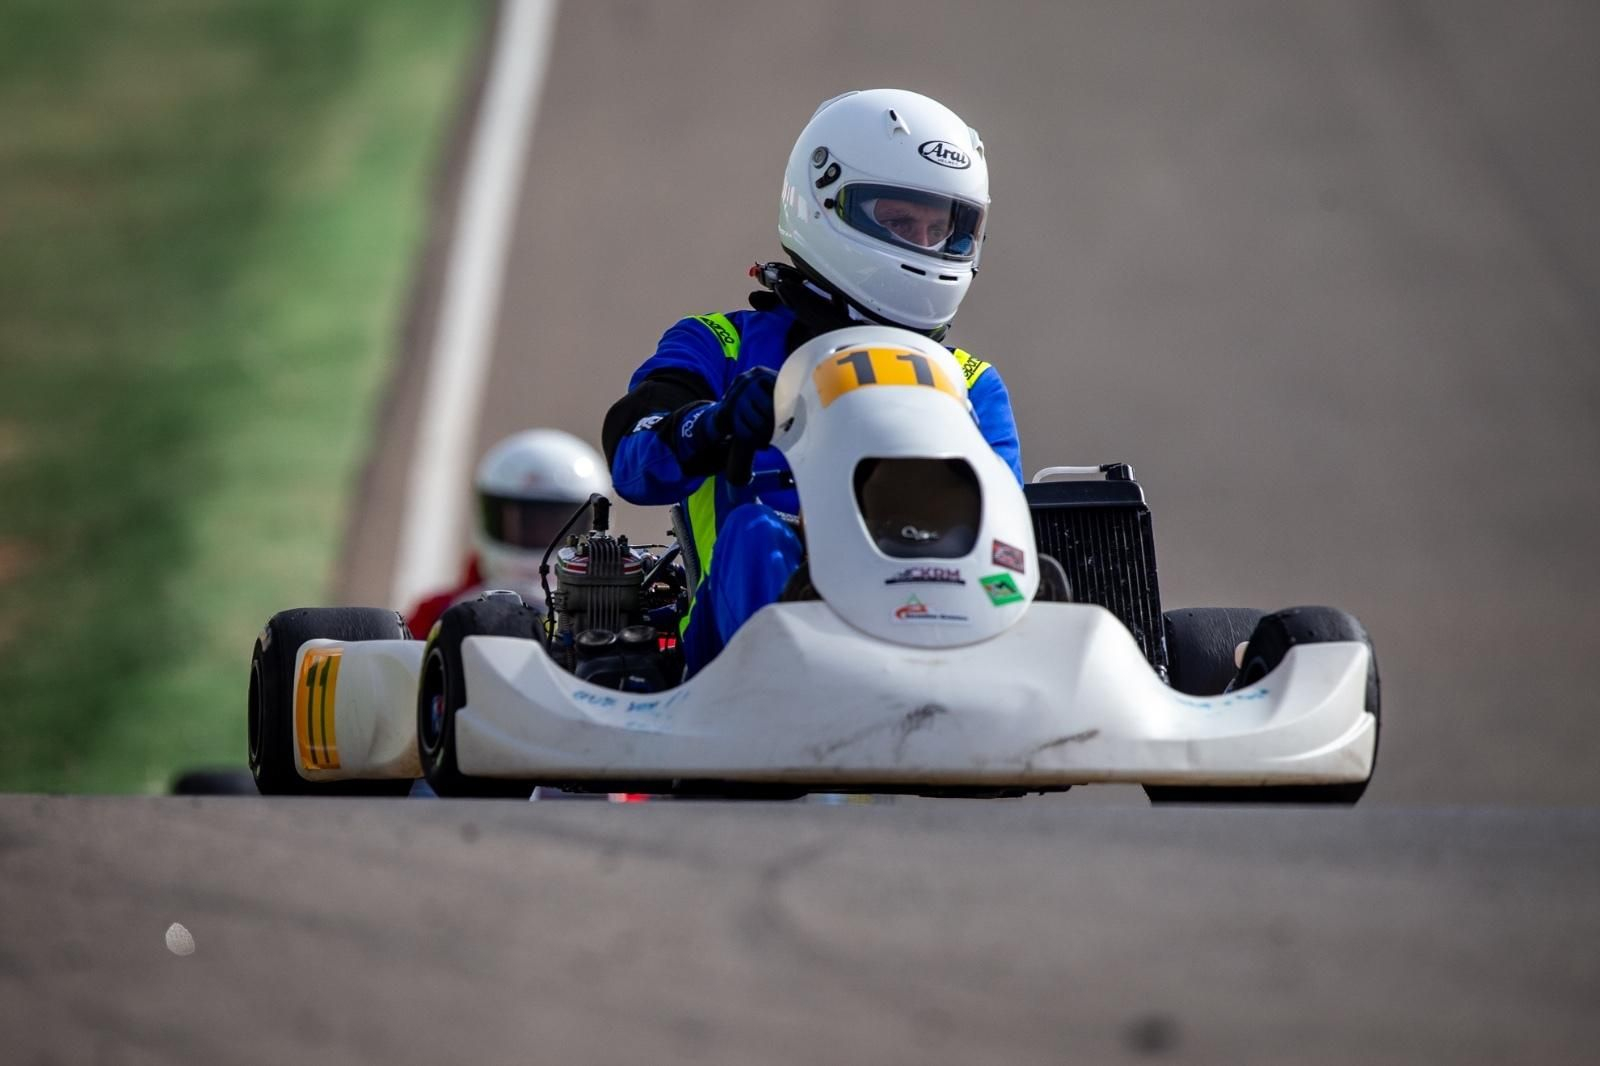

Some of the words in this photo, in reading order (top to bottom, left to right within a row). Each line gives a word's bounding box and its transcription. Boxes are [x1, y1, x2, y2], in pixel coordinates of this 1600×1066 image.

[924, 143, 966, 164] Arai
[836, 350, 936, 388] 11
[306, 655, 331, 765] 11
